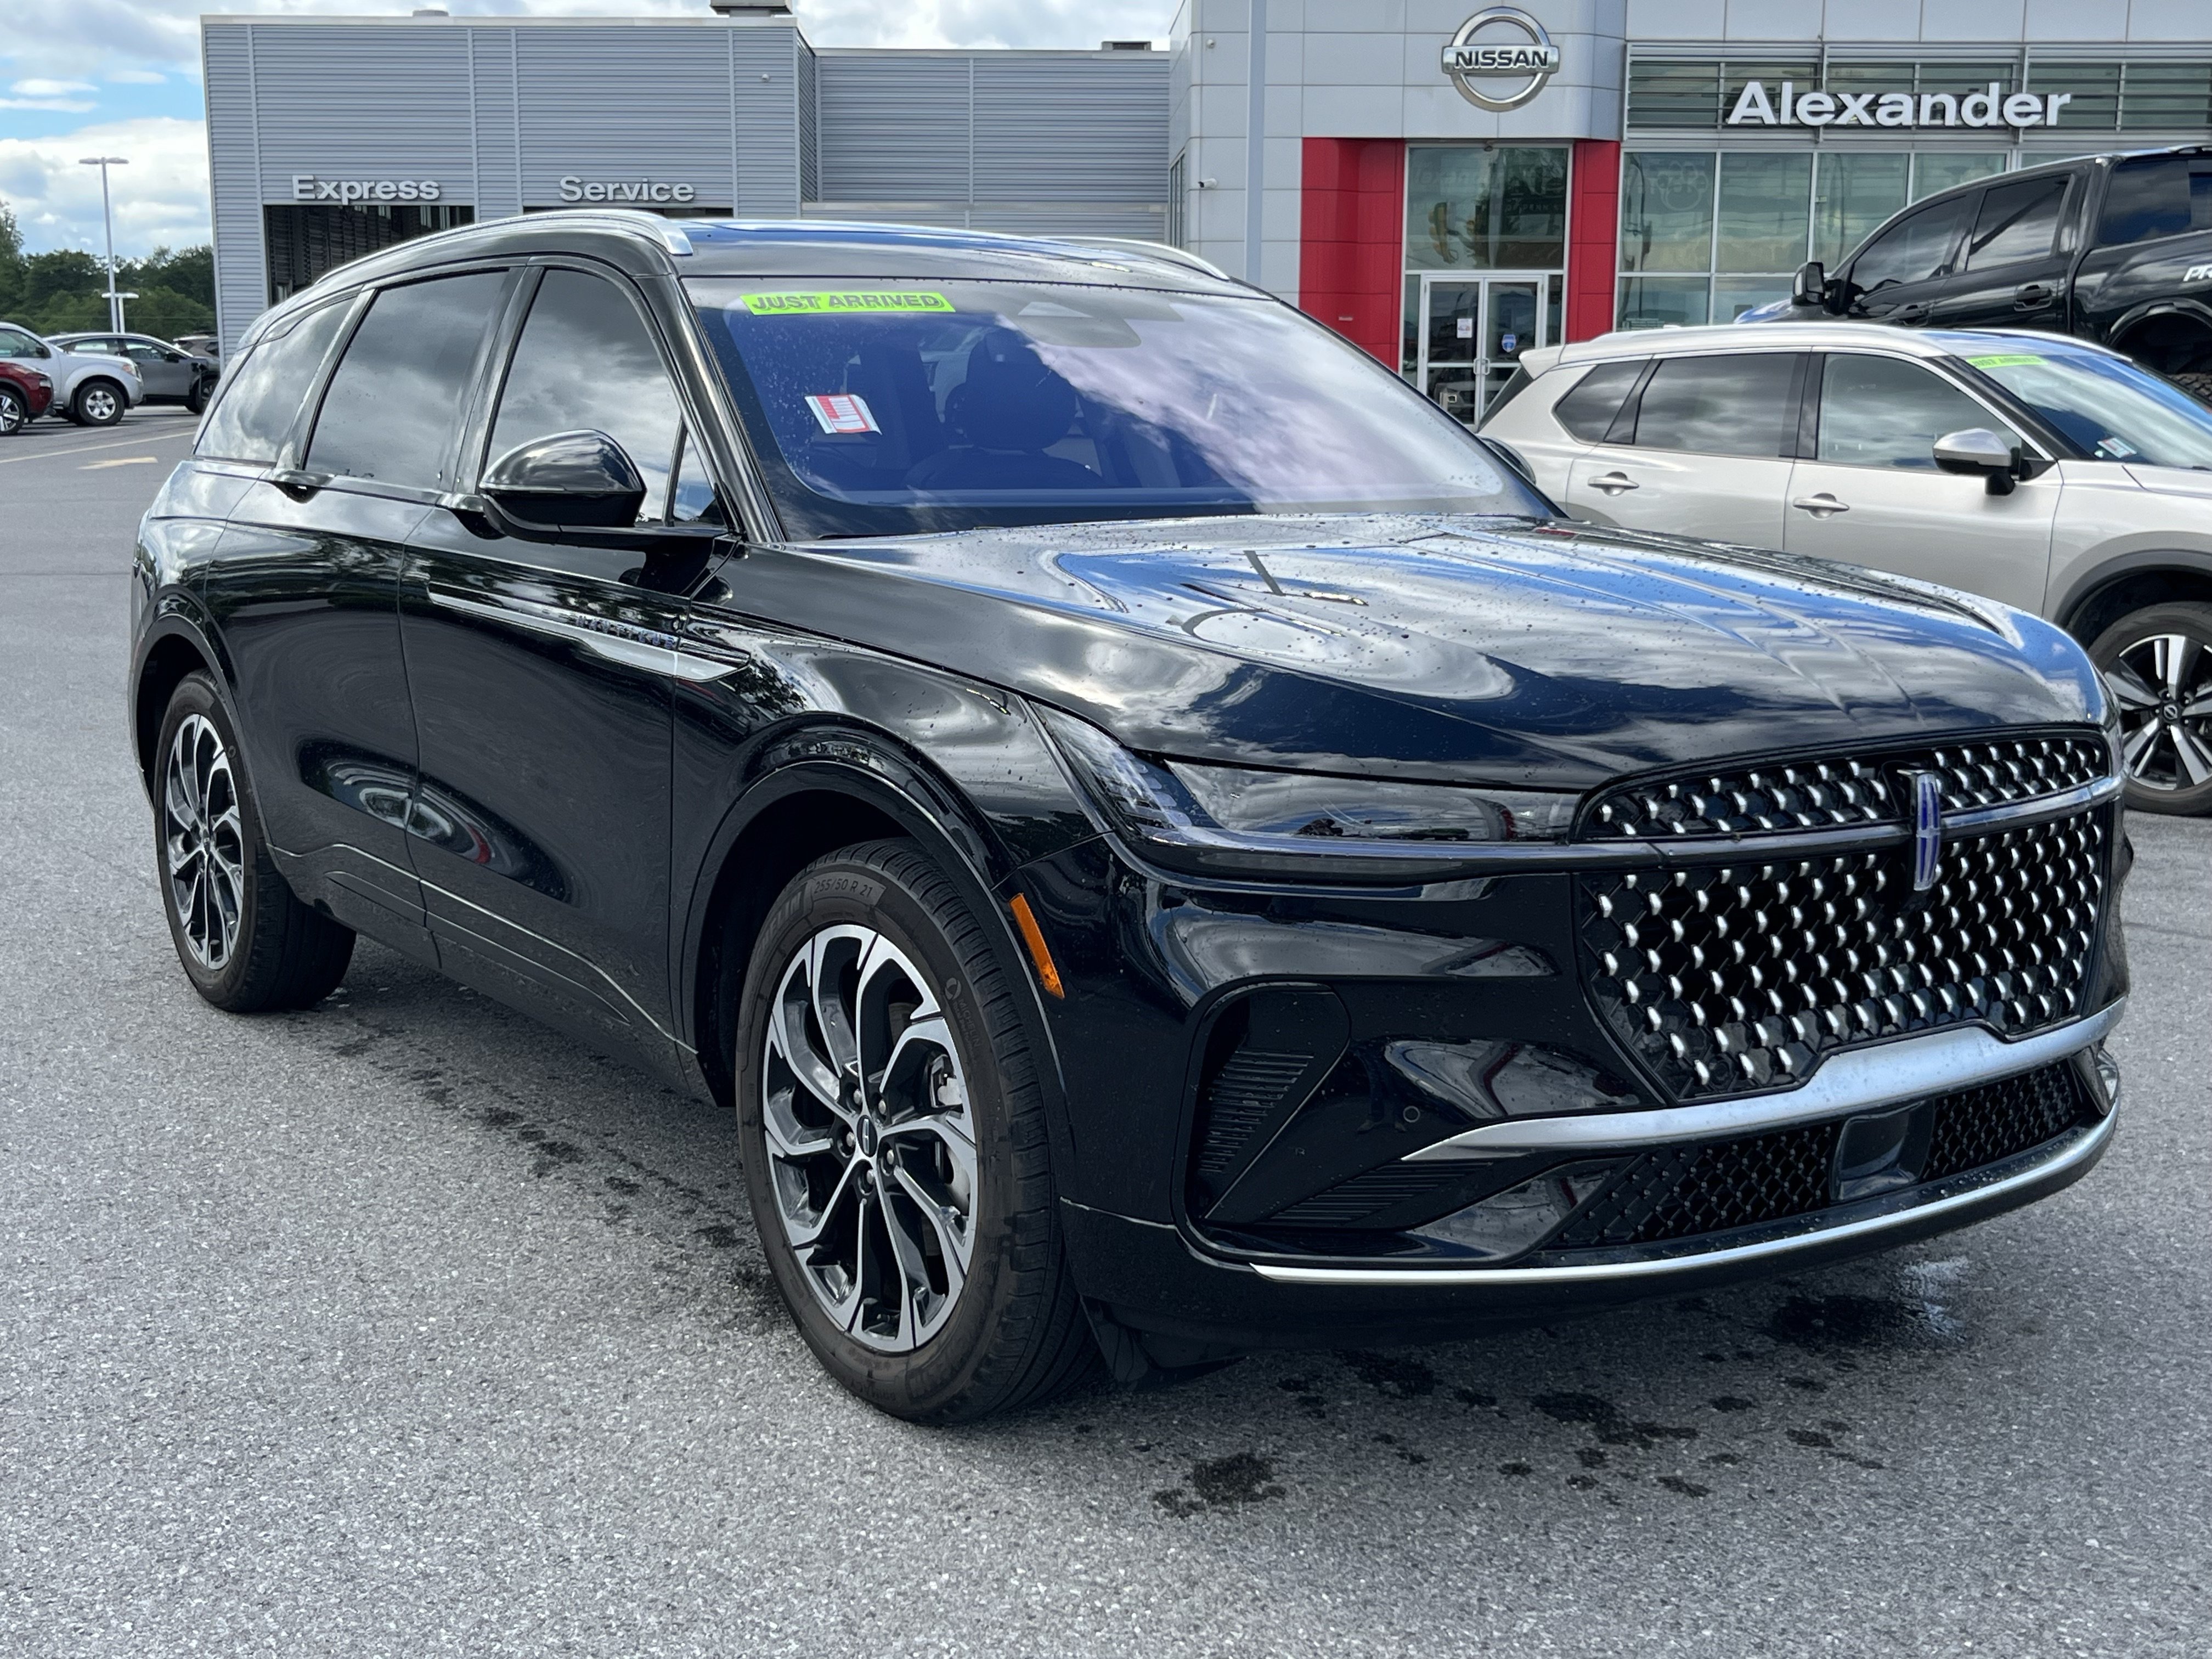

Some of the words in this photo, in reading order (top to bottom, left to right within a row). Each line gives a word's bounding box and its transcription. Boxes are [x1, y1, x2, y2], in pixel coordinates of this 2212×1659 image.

[1454, 50, 1549, 70] NISSAN
[1728, 81, 2071, 128] Alexander
[291, 174, 441, 206] Express
[558, 176, 696, 203] Service
[752, 295, 821, 310] JUST
[828, 295, 945, 308] ARRIVED
[814, 879, 848, 894] 255/50
[850, 880, 857, 893] R
[860, 884, 873, 898] 21
[958, 998, 981, 1048] MICHELIN
